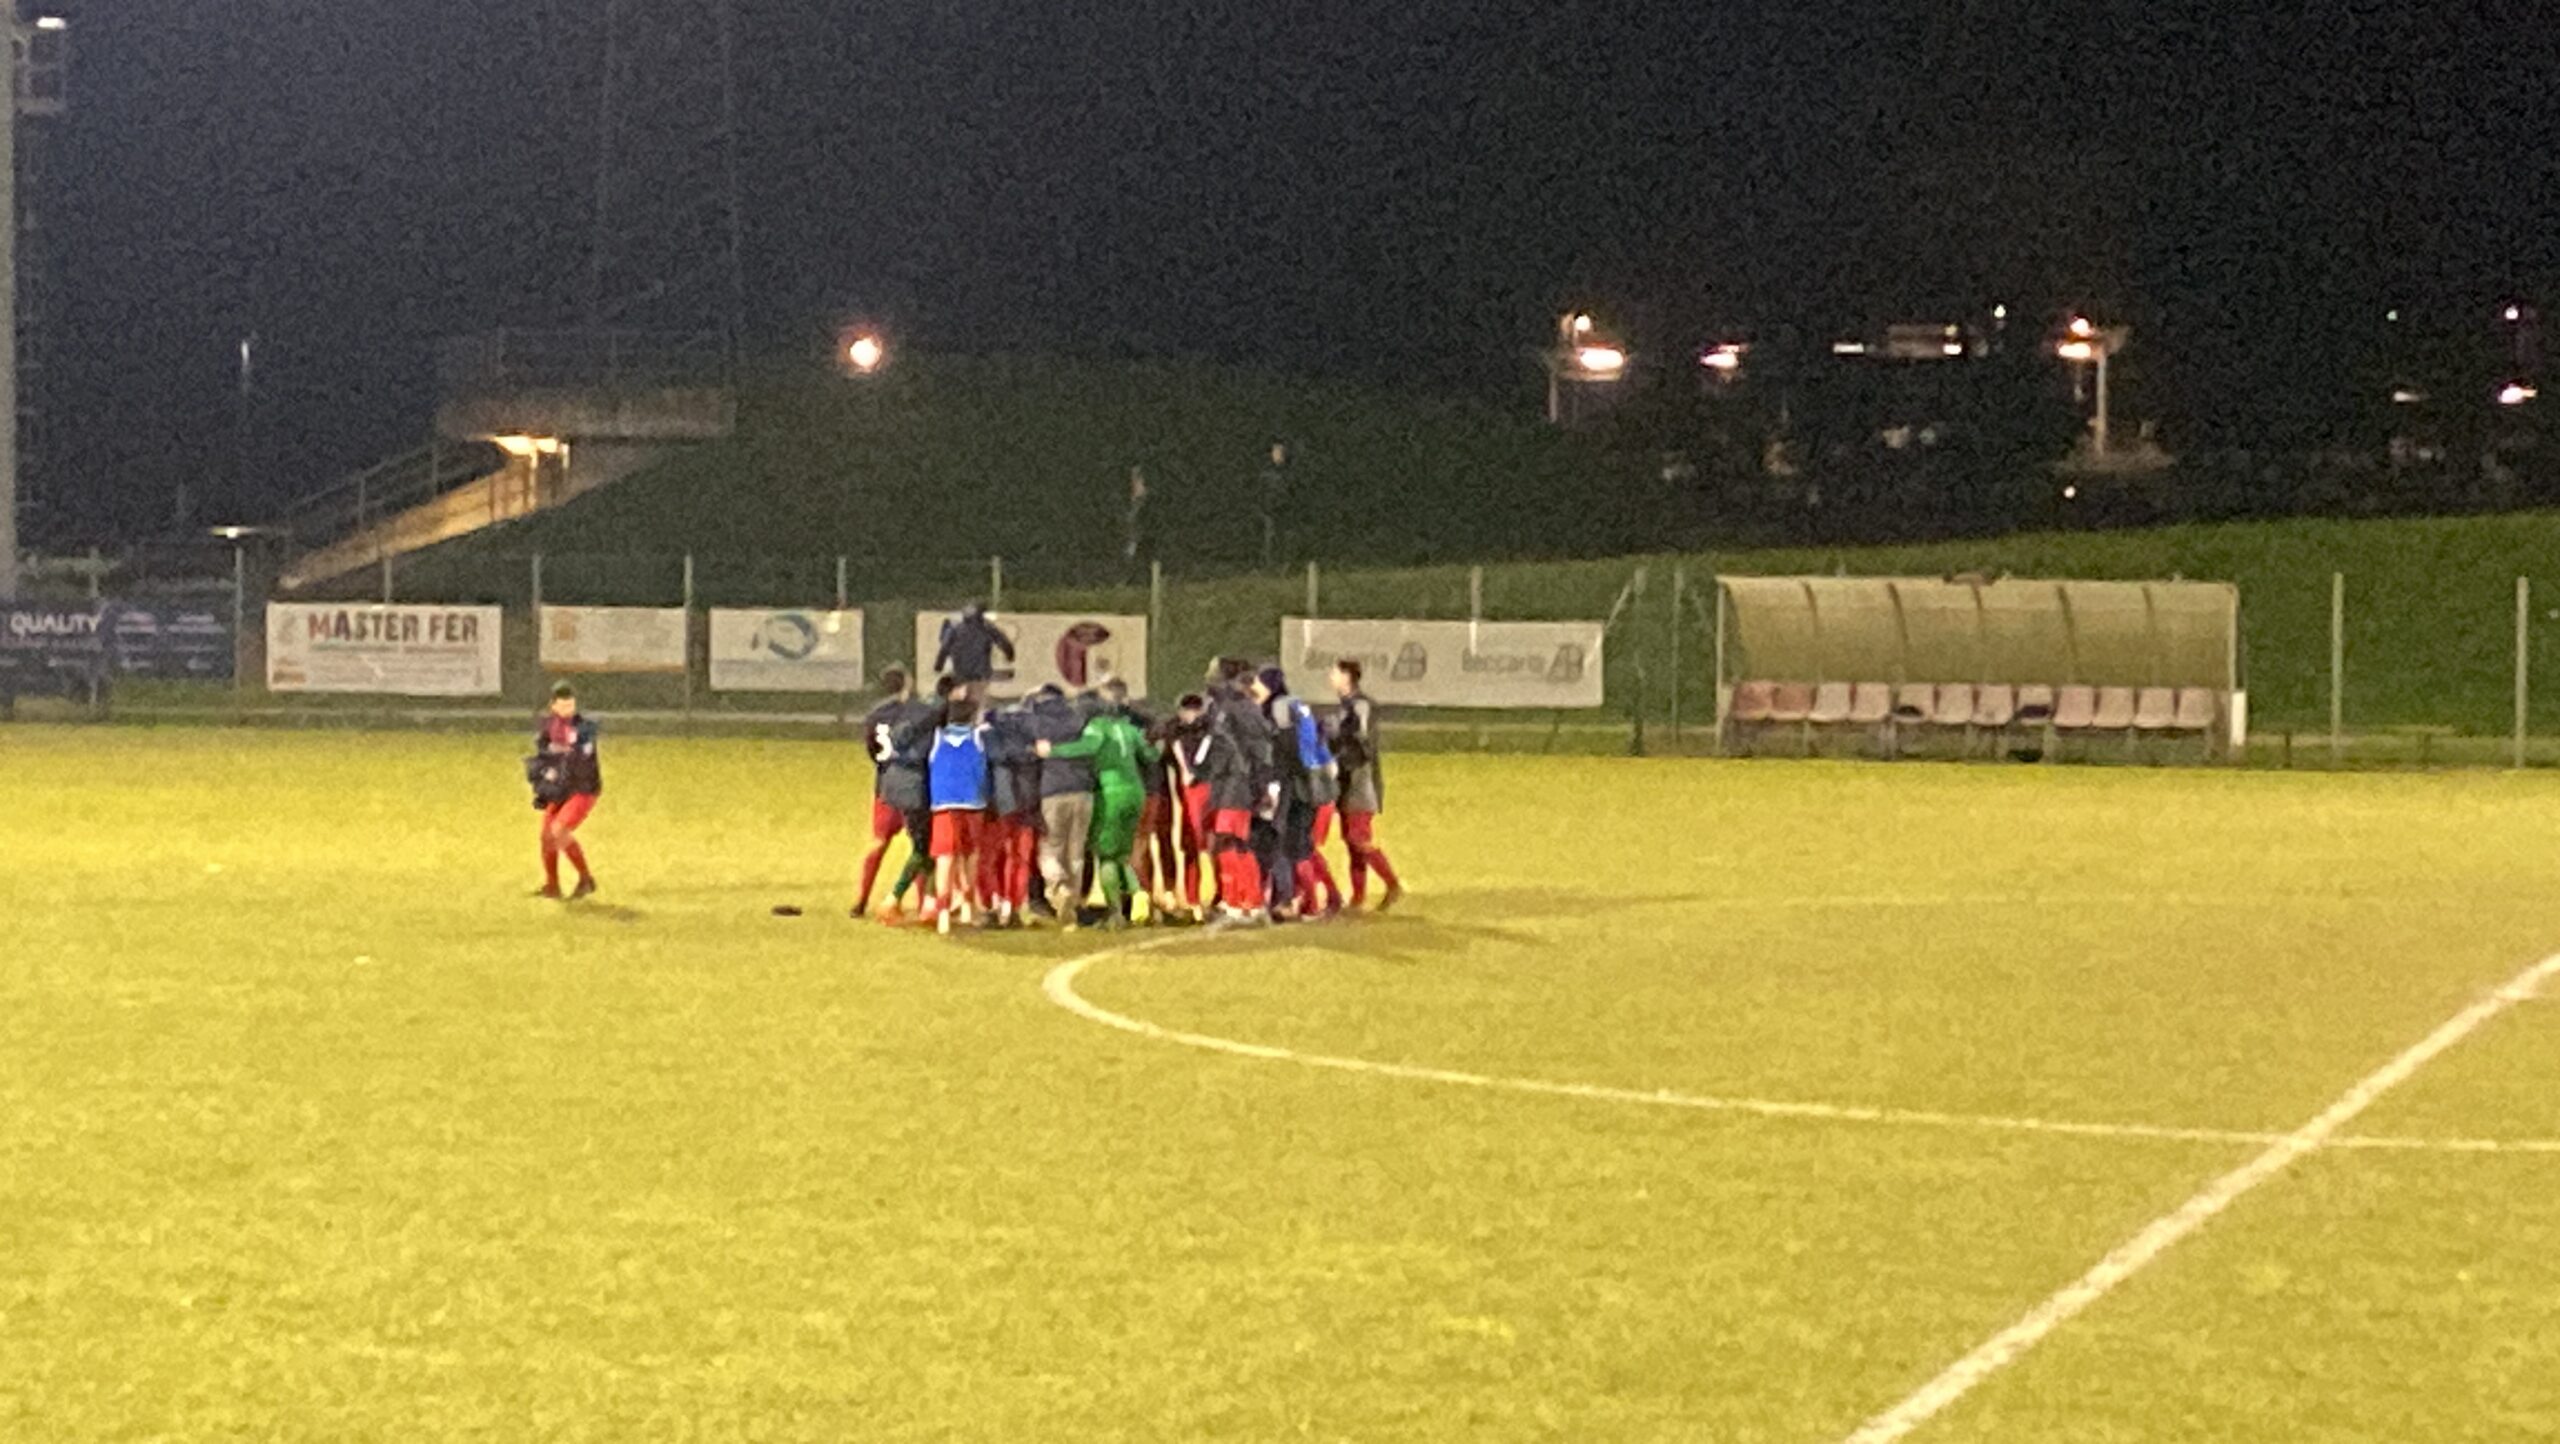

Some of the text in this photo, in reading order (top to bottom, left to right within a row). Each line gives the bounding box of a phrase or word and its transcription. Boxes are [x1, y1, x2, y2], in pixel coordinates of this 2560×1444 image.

[10, 611, 102, 637] QUALITY
[308, 609, 479, 643] MASTER FER
